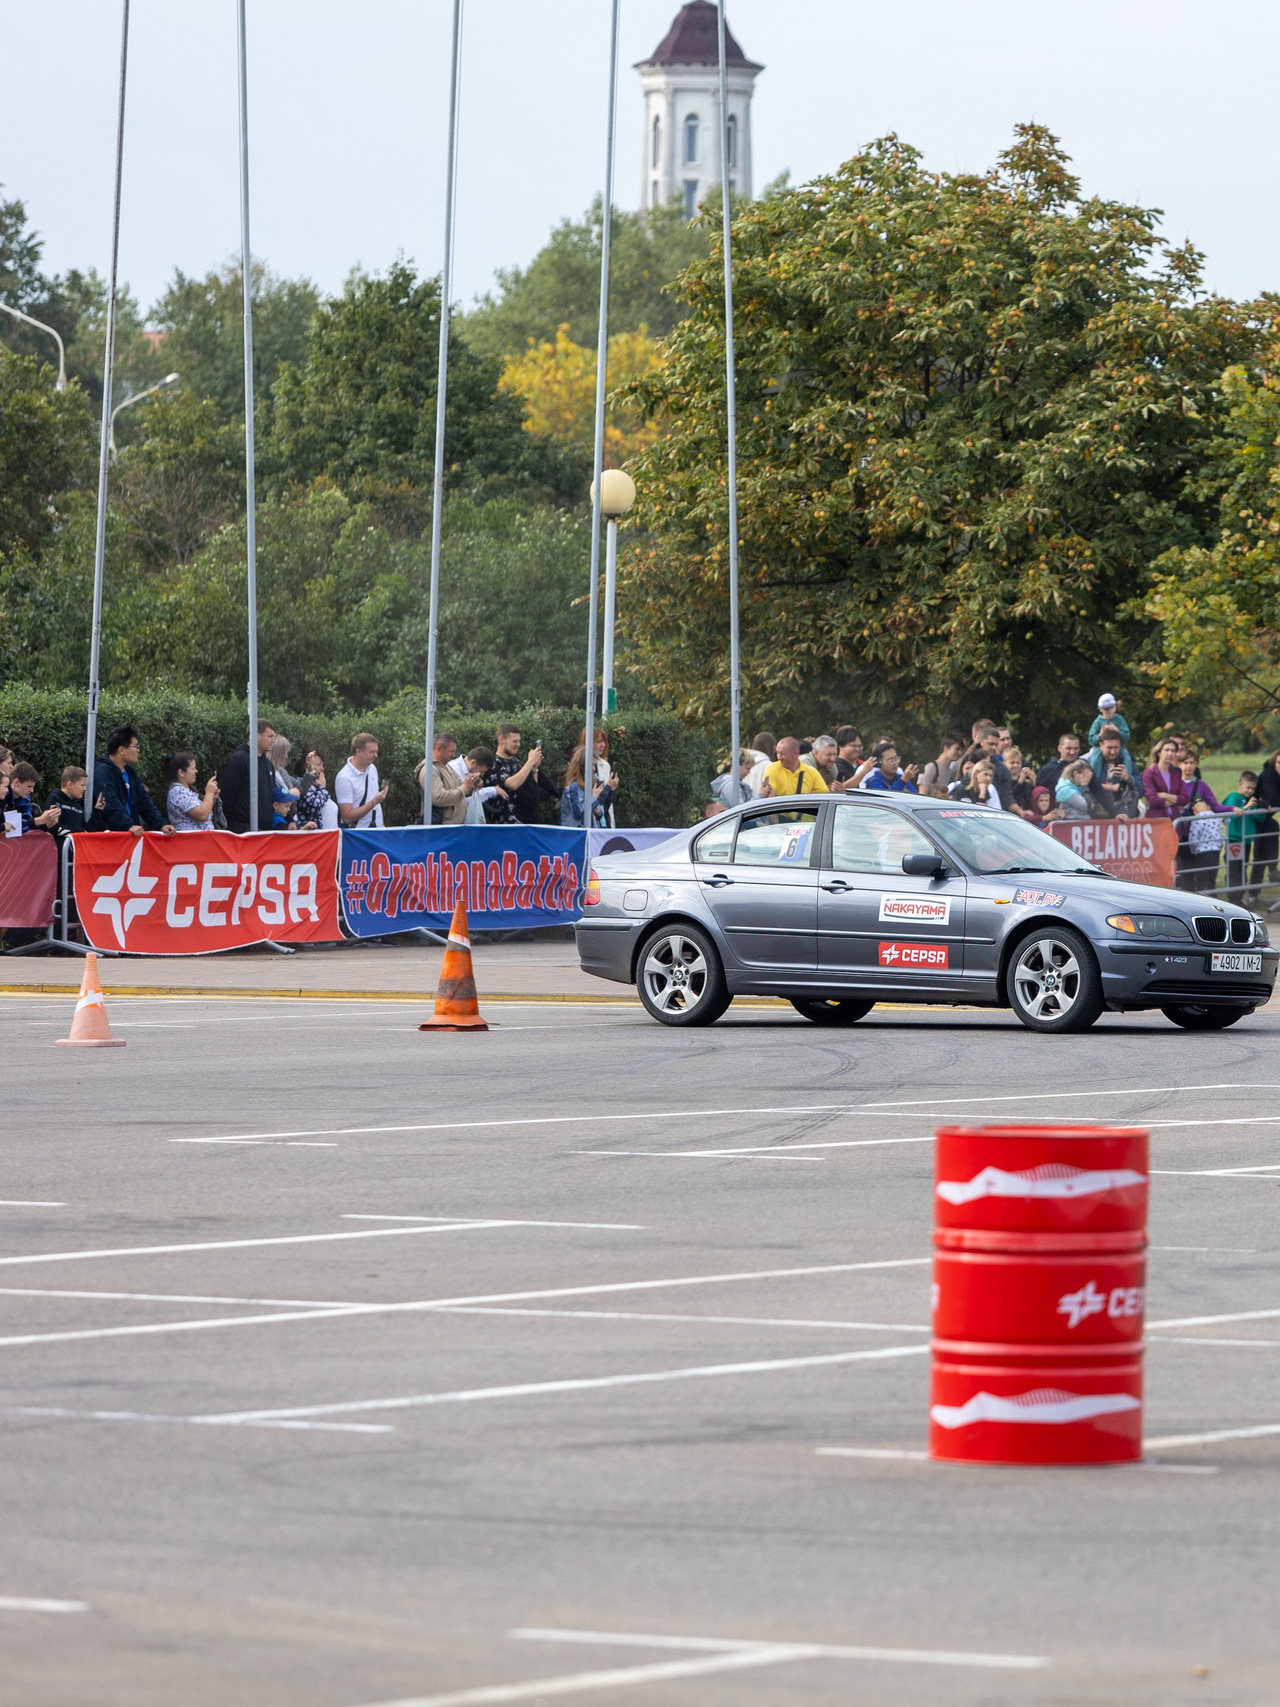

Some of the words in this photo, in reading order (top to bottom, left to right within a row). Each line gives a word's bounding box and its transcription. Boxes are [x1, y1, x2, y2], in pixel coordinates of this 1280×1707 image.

[786, 838, 798, 858] 6
[1071, 823, 1154, 860] BELARUS
[346, 850, 578, 917] #GymkhanaBattle
[165, 861, 320, 928] CEPSA
[884, 902, 946, 916] NAKAYAMA
[902, 948, 946, 964] CEPSA
[1220, 955, 1240, 970] 4902
